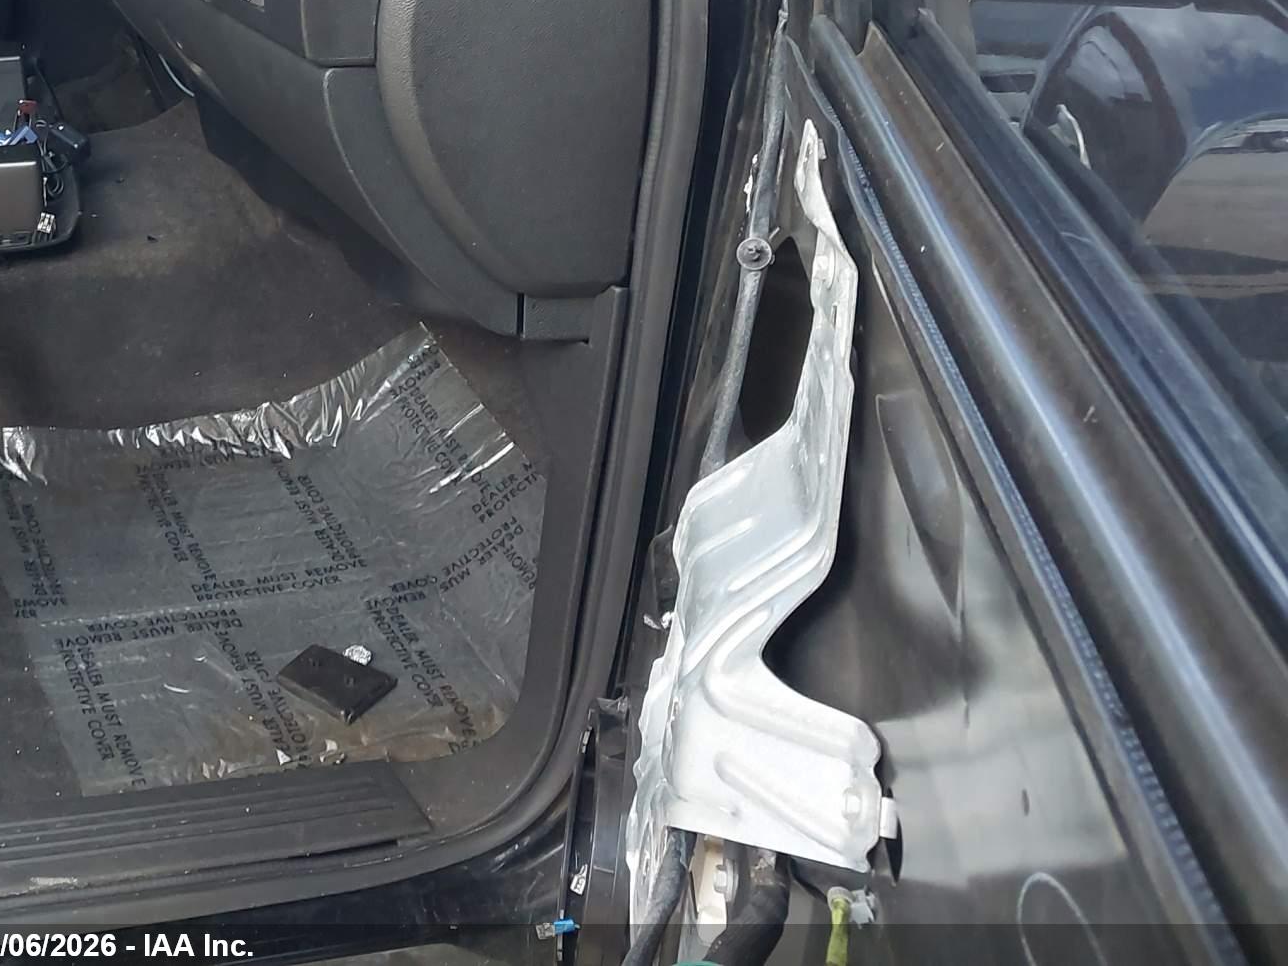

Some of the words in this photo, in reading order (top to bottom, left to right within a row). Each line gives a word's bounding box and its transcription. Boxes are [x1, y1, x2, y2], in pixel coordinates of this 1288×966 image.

[442, 516, 518, 576] PROTECTIVE
[191, 579, 245, 594] DEALER
[256, 572, 297, 585] MUST
[305, 559, 368, 578] REMOVE
[196, 584, 284, 603] PROTECTIVE
[292, 575, 342, 590] COVER
[439, 568, 470, 592] MUS
[88, 621, 138, 633] COVER
[131, 625, 175, 641] MUST
[145, 608, 238, 628] PROTECTIVE
[186, 618, 243, 634] DEALER
[54, 633, 123, 651] REMOVE
[214, 631, 249, 672] REMOVE
[370, 609, 418, 670] PROTECTIVE
[60, 648, 97, 715] PROTECTIVE
[88, 720, 116, 761] COVER
[242, 677, 268, 711] MUST
[415, 649, 445, 679] MUST
[440, 684, 477, 736] REMOVE
[76, 647, 105, 687] DEALER
[97, 690, 122, 727] MUST
[114, 733, 147, 786] REMOVE
